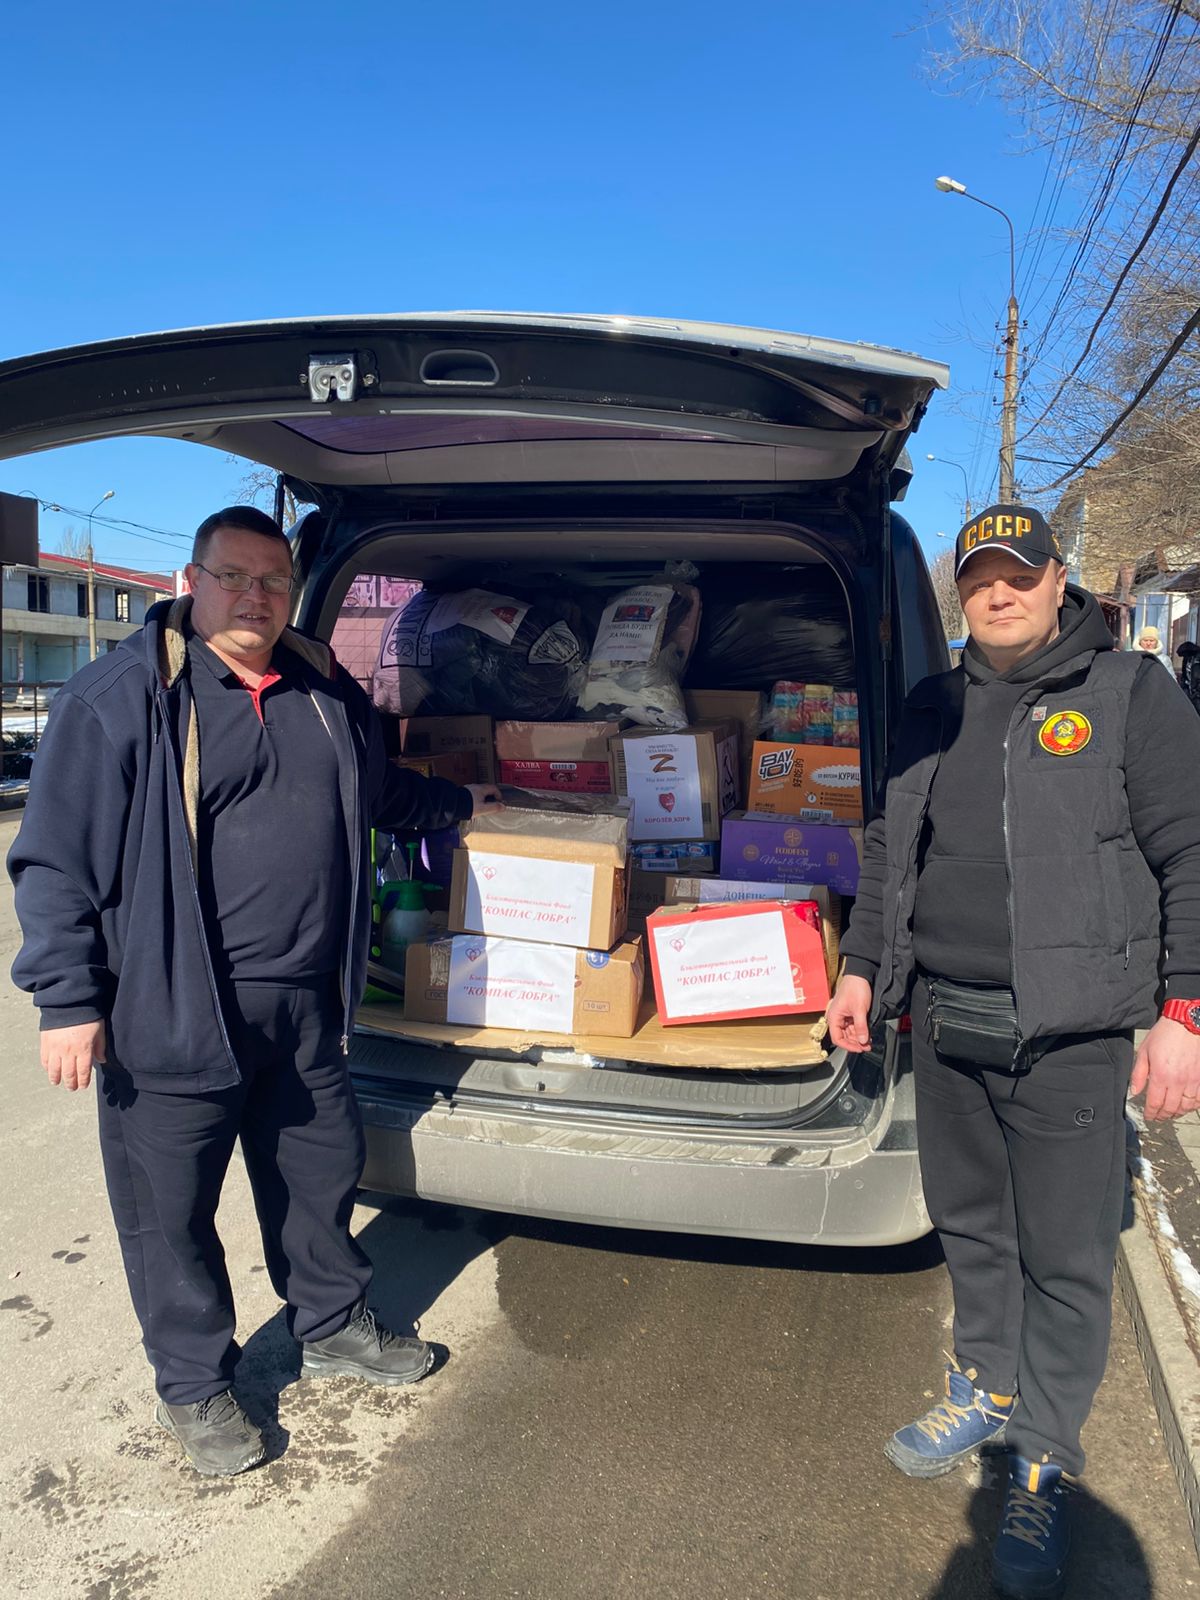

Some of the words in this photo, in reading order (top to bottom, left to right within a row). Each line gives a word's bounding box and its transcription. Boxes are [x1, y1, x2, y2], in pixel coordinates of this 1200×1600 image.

[964, 514, 1032, 551] СССР
[514, 761, 541, 769] ХАЛВА
[486, 893, 552, 907] Благотворительный
[553, 900, 571, 909] Фонд
[680, 958, 748, 972] Благотворительный
[750, 954, 768, 963] Фонд
[537, 978, 555, 988] Фонд
